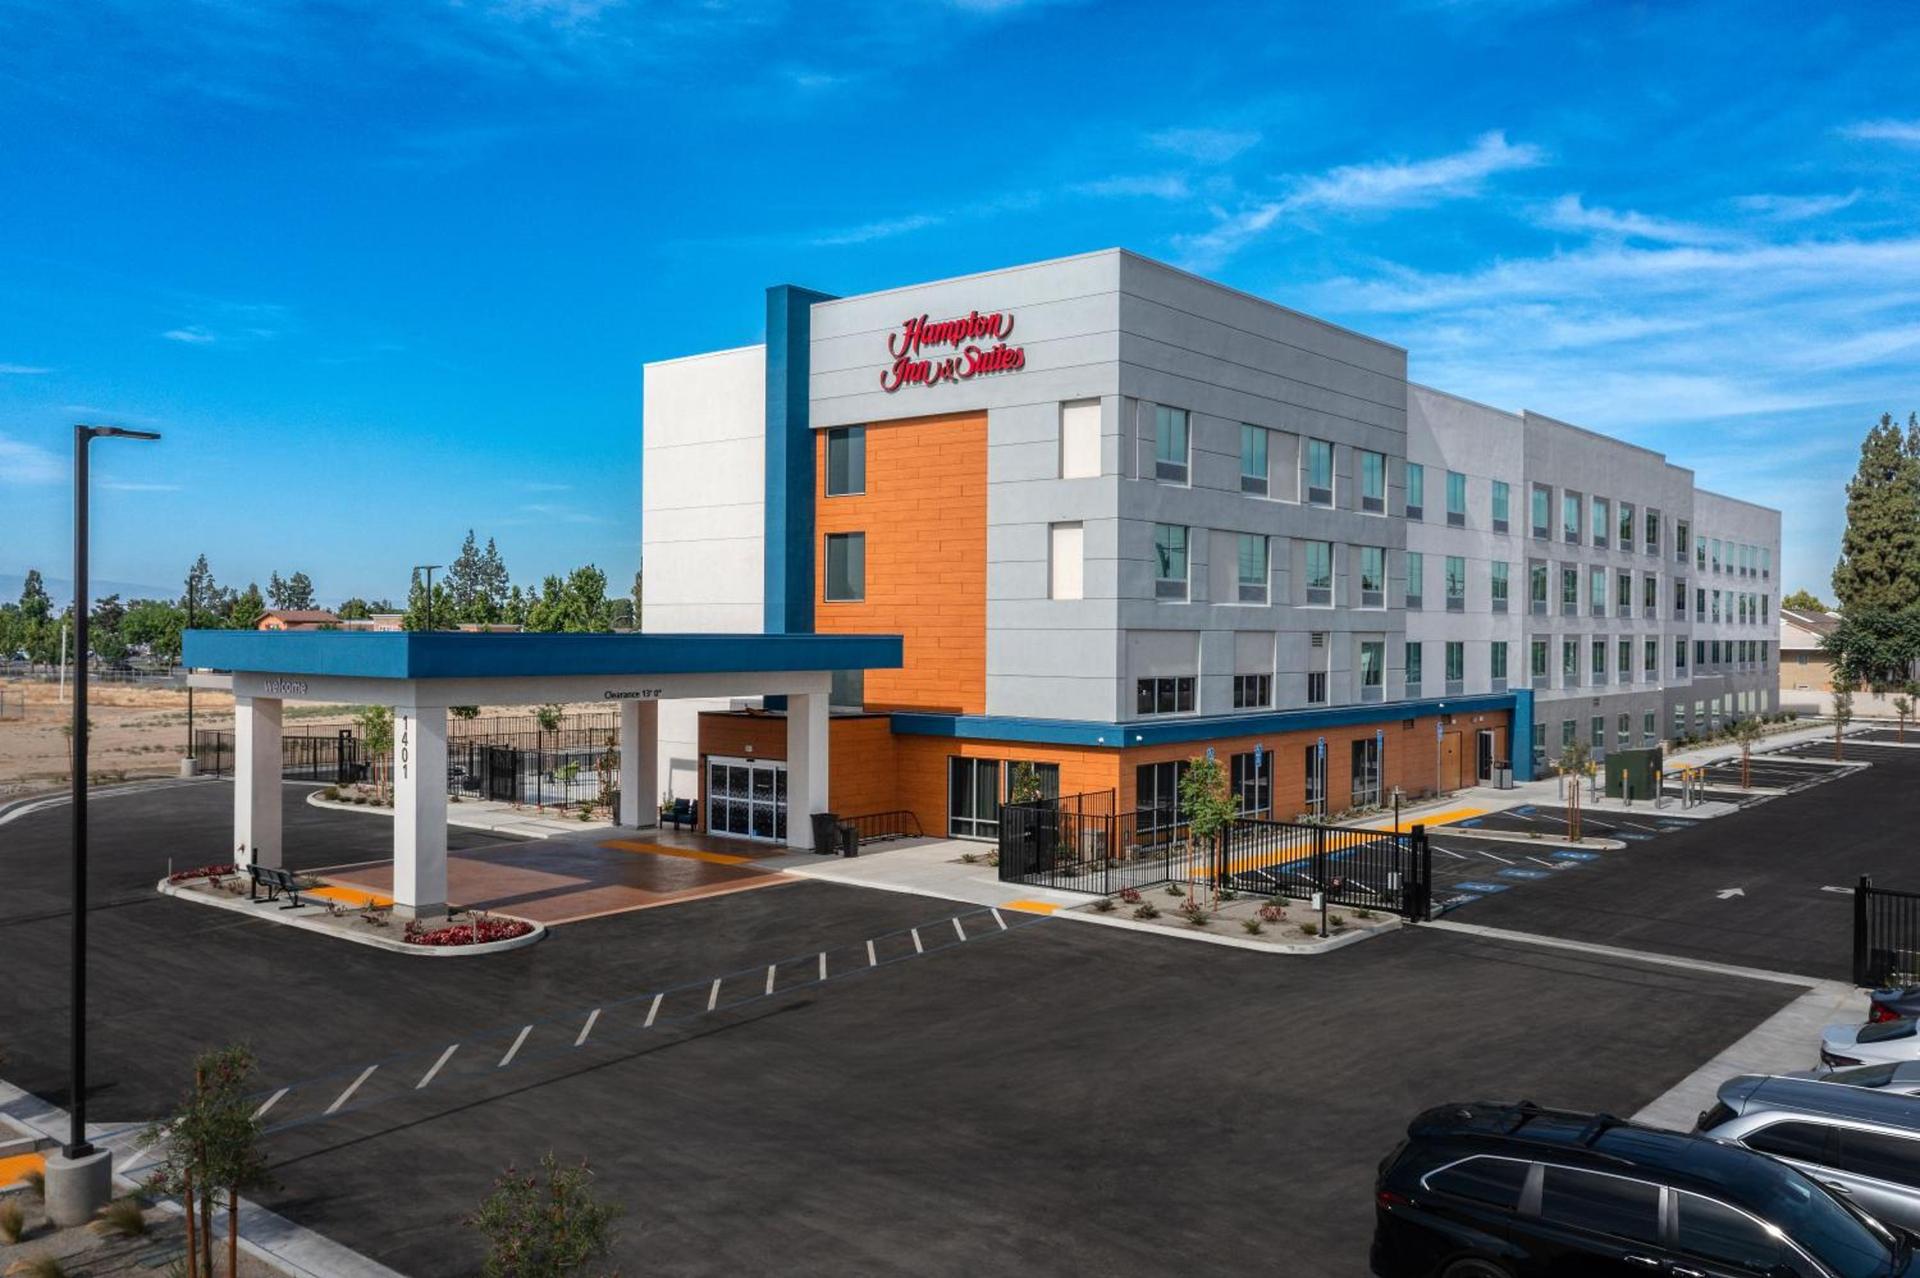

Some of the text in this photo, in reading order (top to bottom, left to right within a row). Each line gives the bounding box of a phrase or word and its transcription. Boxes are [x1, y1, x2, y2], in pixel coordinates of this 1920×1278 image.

[888, 311, 1014, 359] Hampton
[880, 356, 942, 393] Inn
[955, 343, 1026, 379] Suites
[264, 678, 308, 694] welcome
